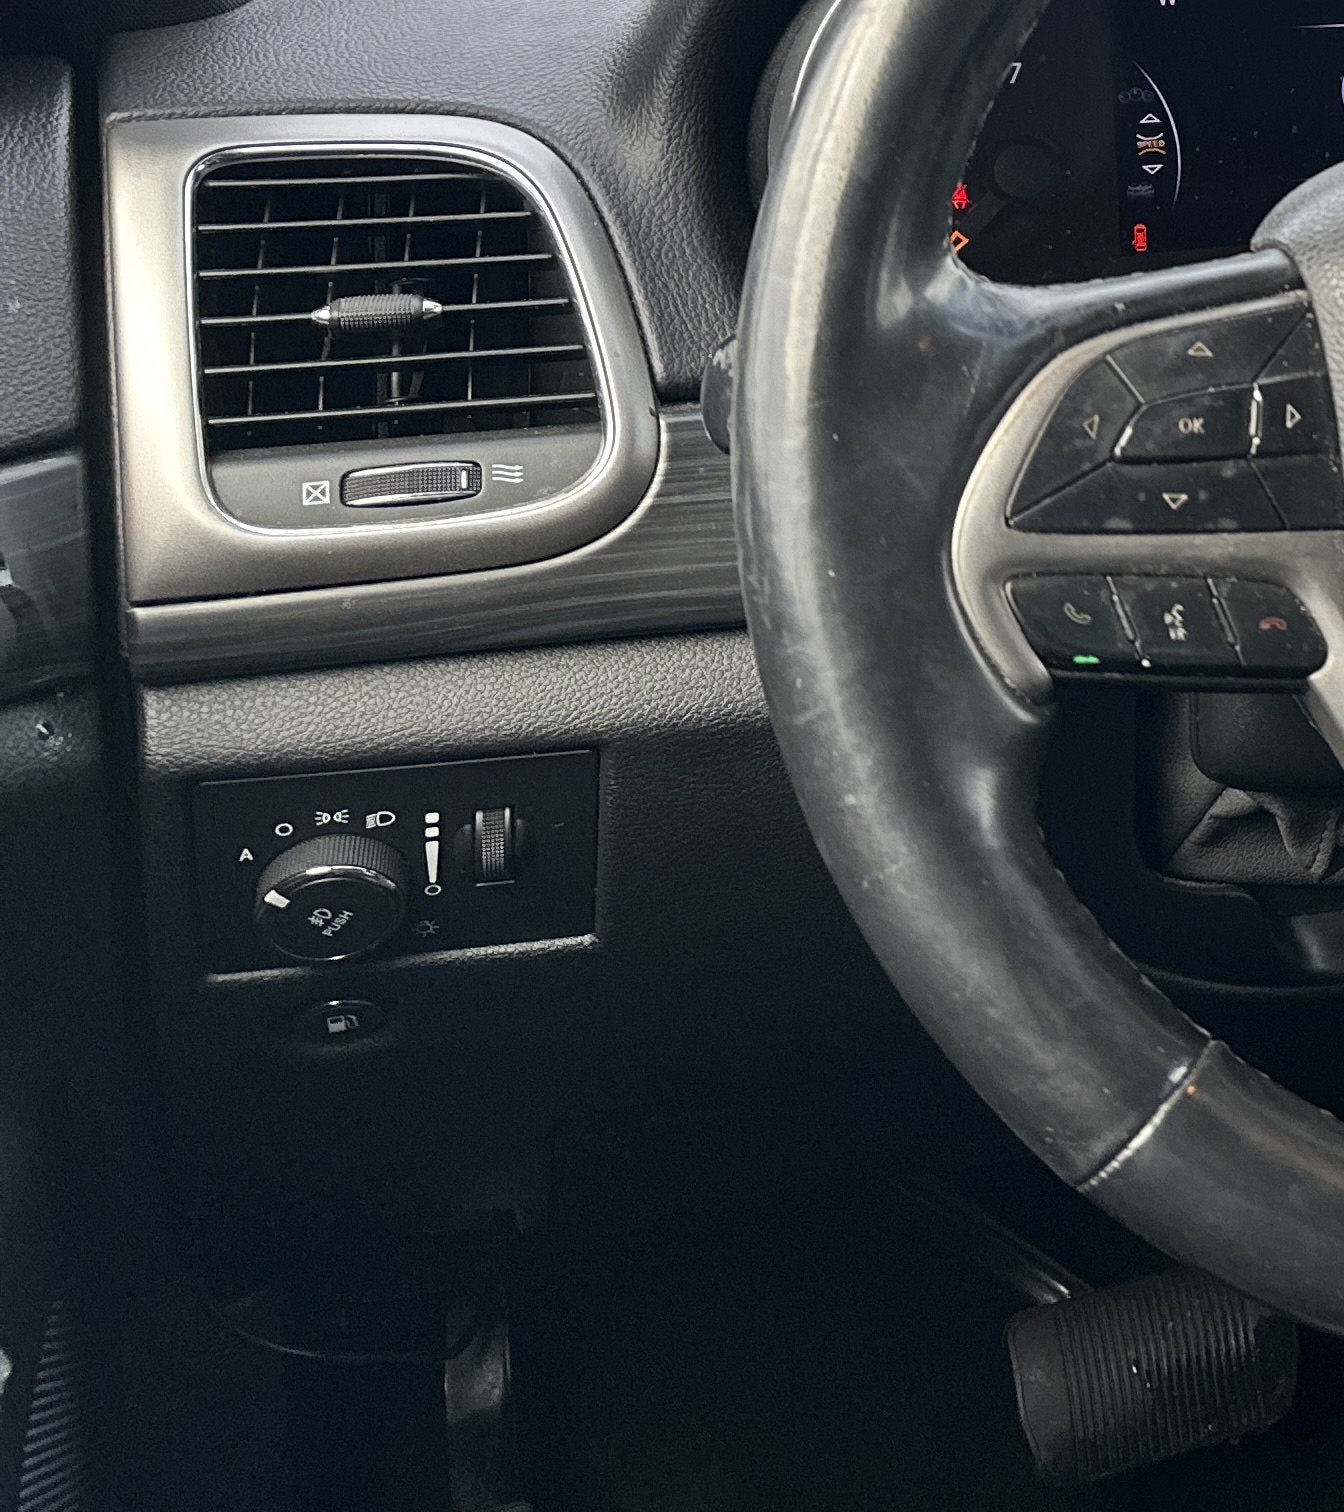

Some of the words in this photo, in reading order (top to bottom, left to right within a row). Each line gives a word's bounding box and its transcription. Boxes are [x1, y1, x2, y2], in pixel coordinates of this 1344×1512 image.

[1176, 418, 1206, 434] OK
[238, 847, 254, 862] A
[322, 909, 354, 938] PUSH
